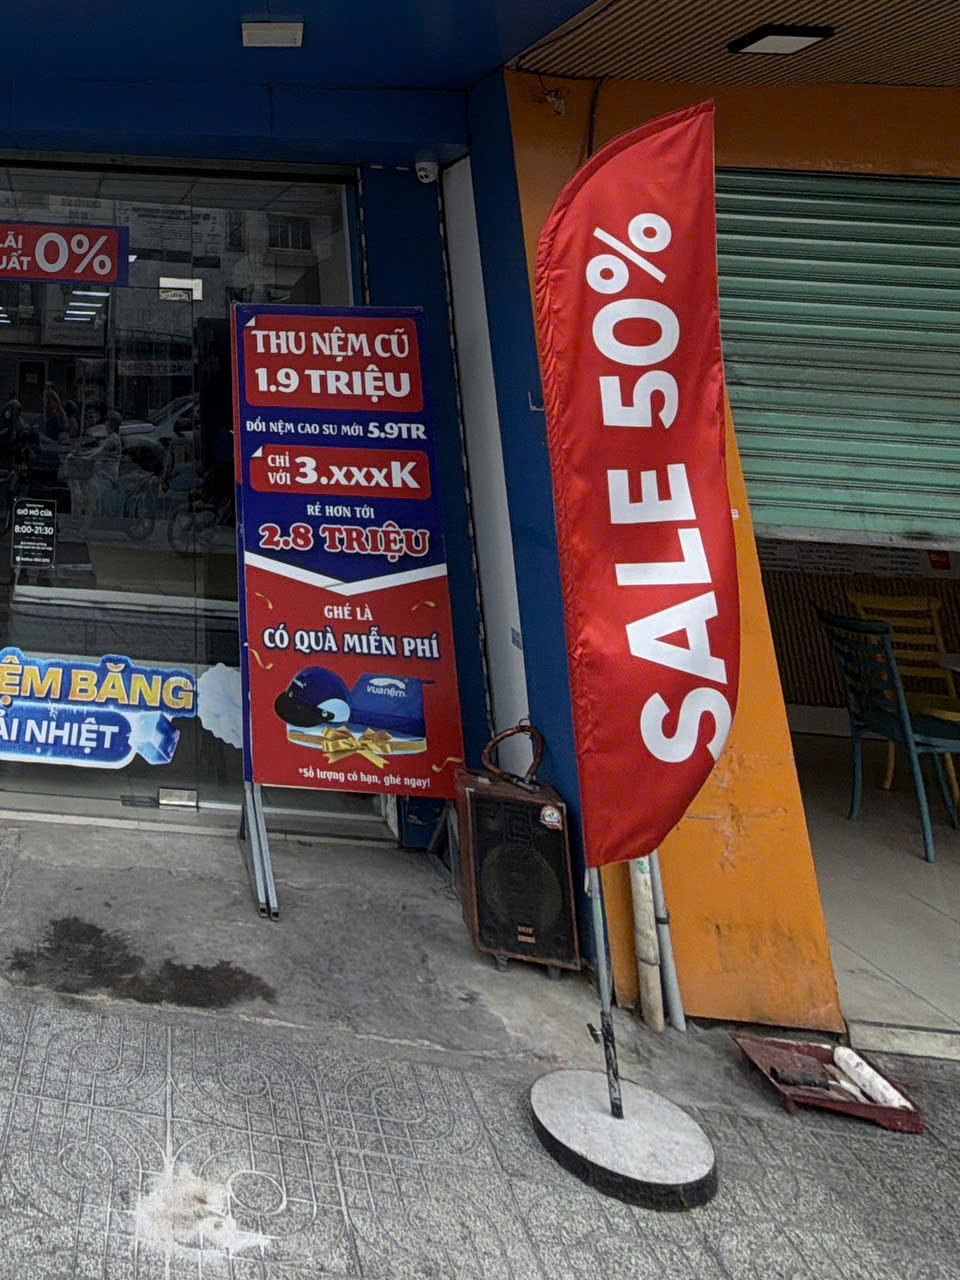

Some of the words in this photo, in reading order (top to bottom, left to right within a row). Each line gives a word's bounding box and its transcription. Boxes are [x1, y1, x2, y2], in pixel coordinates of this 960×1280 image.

[35, 231, 113, 276] 0%
[585, 210, 681, 430] 50%
[250, 330, 306, 355] THU
[311, 326, 371, 363] NỆM
[374, 328, 409, 359] CŨ
[255, 367, 300, 394] 1.9
[304, 364, 411, 403] TRIỆU
[246, 415, 266, 433] ĐỔI
[269, 419, 295, 436] NỆM
[297, 422, 320, 435] CAO
[322, 424, 338, 436] SU
[341, 423, 364, 437] MỚI
[366, 421, 428, 440] 5.9TR
[267, 451, 290, 468] CHỈ
[294, 455, 421, 489] 3.xxxK
[267, 470, 292, 486] VỚI
[306, 501, 322, 517] RẺ
[325, 504, 352, 518] HƠN
[354, 502, 375, 519] TỚI
[258, 521, 314, 551] 2.8
[319, 519, 431, 563] TRIỆU
[323, 602, 353, 620] GHÉ
[355, 603, 374, 621] LÀ
[608, 462, 734, 764] SALE
[262, 623, 290, 650] CÓ
[294, 625, 339, 654] QUÀ
[343, 626, 397, 657] MIỄN
[401, 632, 440, 659] PHÍ
[67, 662, 194, 710] BĂNG
[24, 716, 120, 755] NHIỆT
[316, 767, 345, 783] lượng
[347, 772, 358, 782] có
[383, 773, 402, 787] ghé
[403, 776, 431, 790] ngay!
